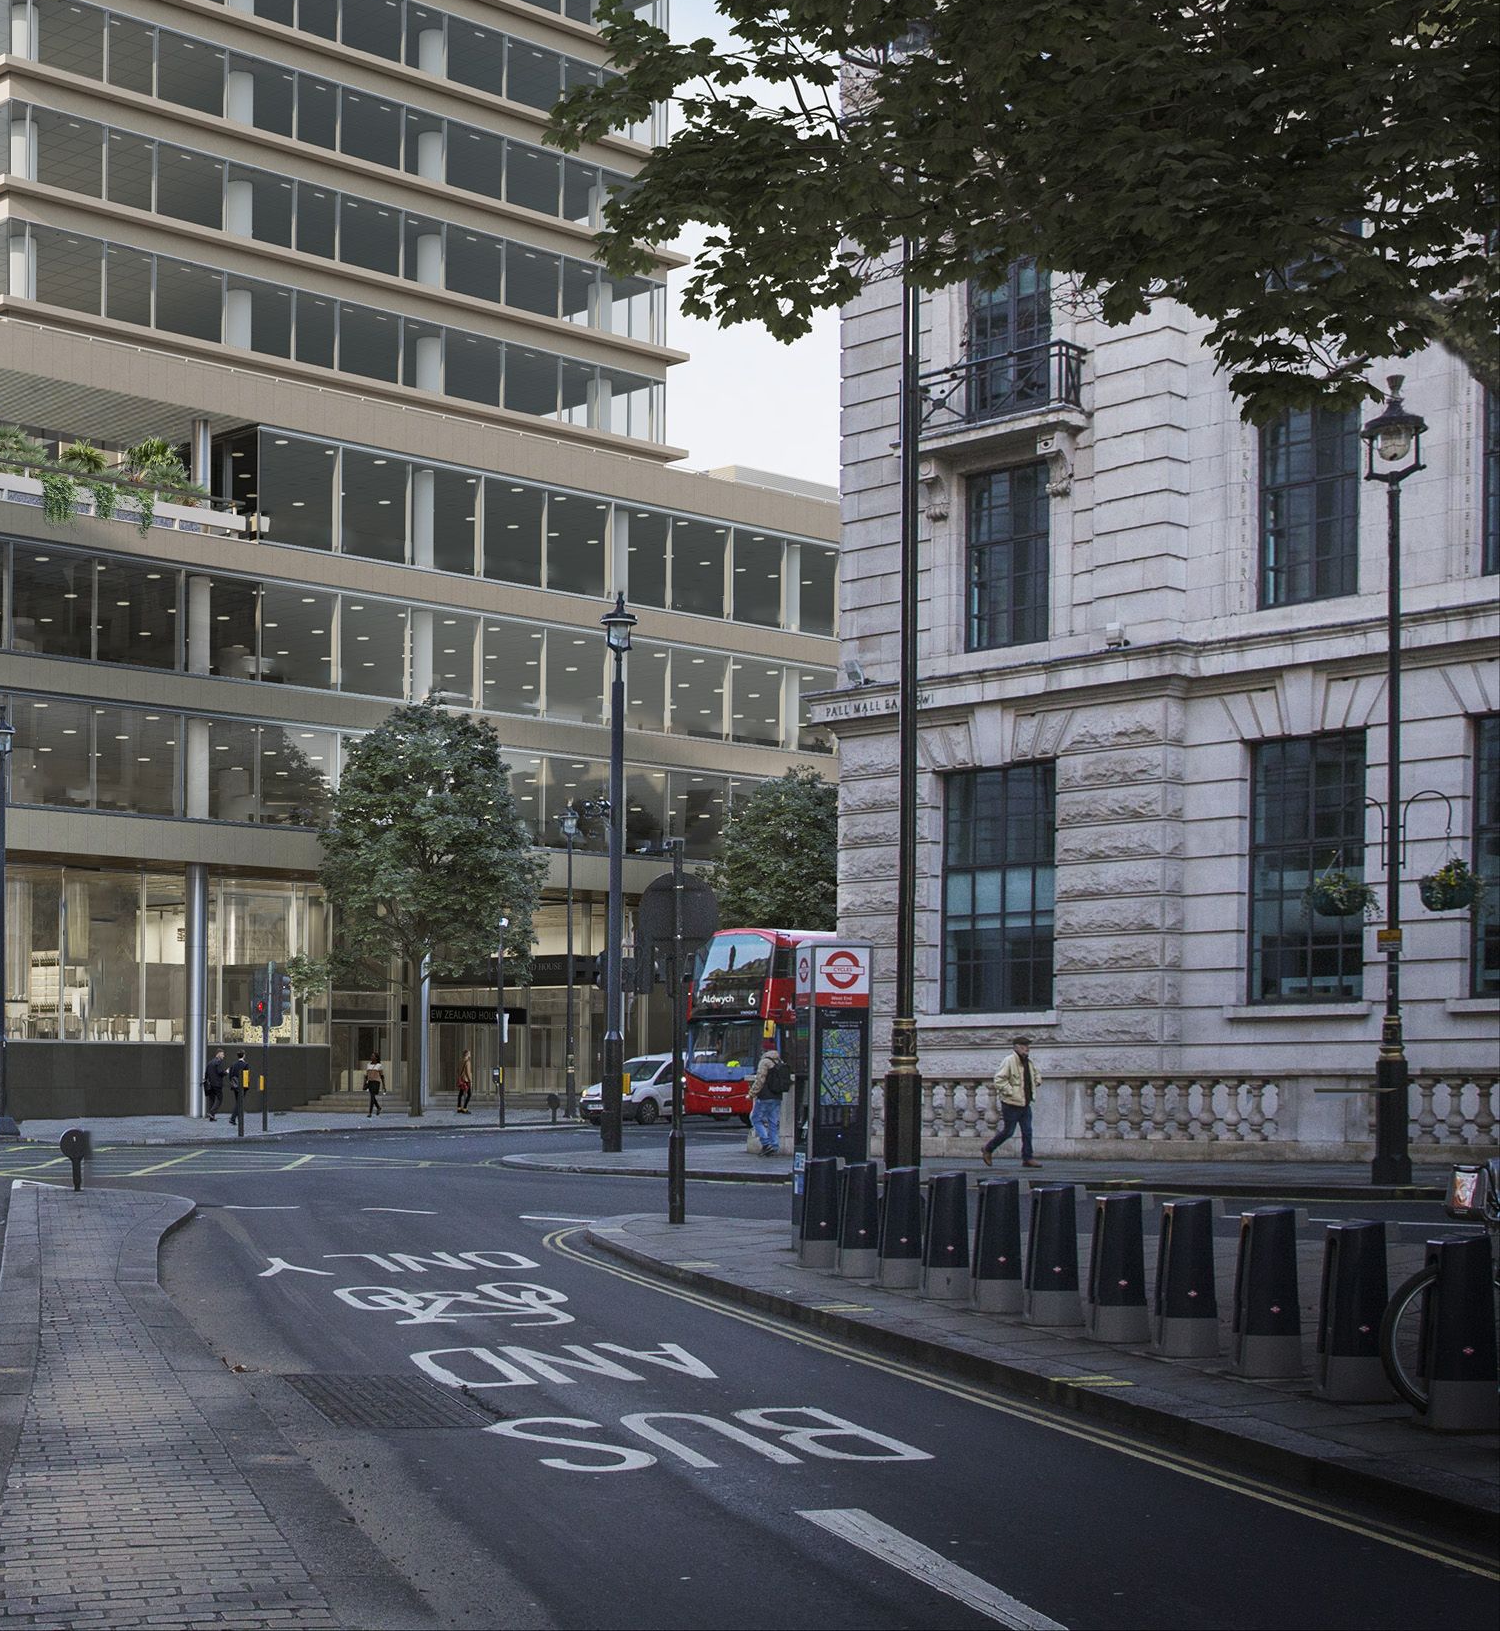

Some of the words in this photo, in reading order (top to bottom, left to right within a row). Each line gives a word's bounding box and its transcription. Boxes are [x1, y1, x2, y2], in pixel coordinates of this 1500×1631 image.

[826, 705, 849, 717] PALL
[853, 700, 880, 713] MALL
[885, 699, 899, 710] EA
[702, 994, 735, 1005] Aldwych
[748, 992, 756, 1006] 6
[431, 1010, 442, 1019] EW
[444, 1010, 477, 1020] ZEALAND
[479, 1011, 498, 1021] HOUS
[258, 1251, 541, 1277] ONLY
[409, 1342, 720, 1388] AND
[482, 1406, 936, 1472] BUS
